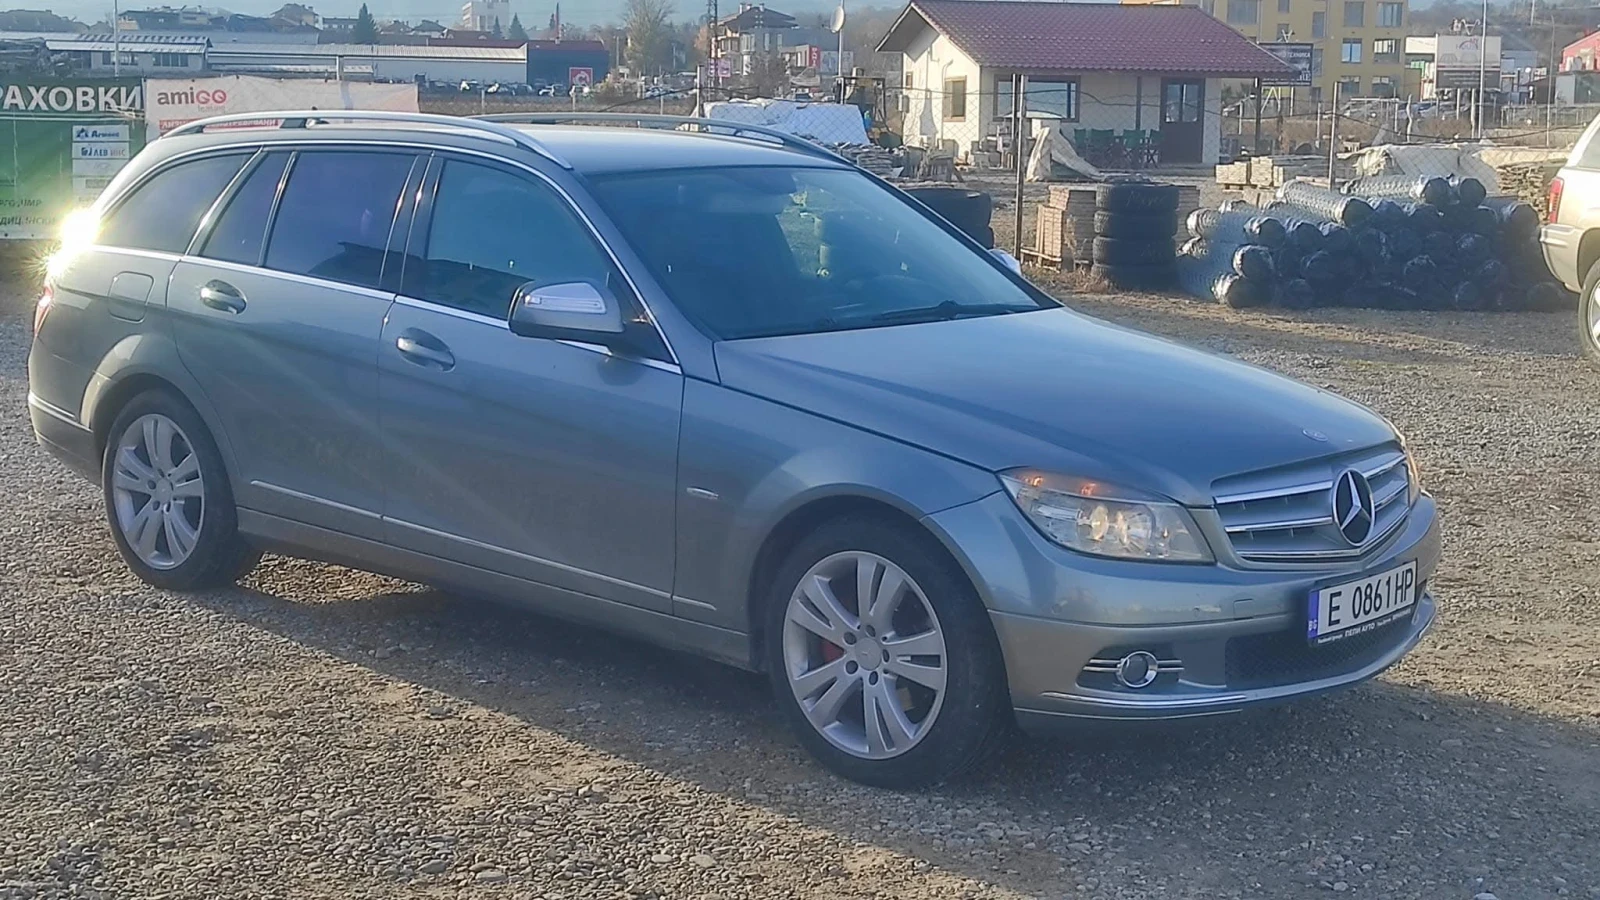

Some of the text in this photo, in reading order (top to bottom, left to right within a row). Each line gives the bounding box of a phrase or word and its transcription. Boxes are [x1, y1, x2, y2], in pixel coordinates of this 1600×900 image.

[0, 85, 142, 111] АХОВКИ
[1328, 568, 1414, 627] E 0861 HP
